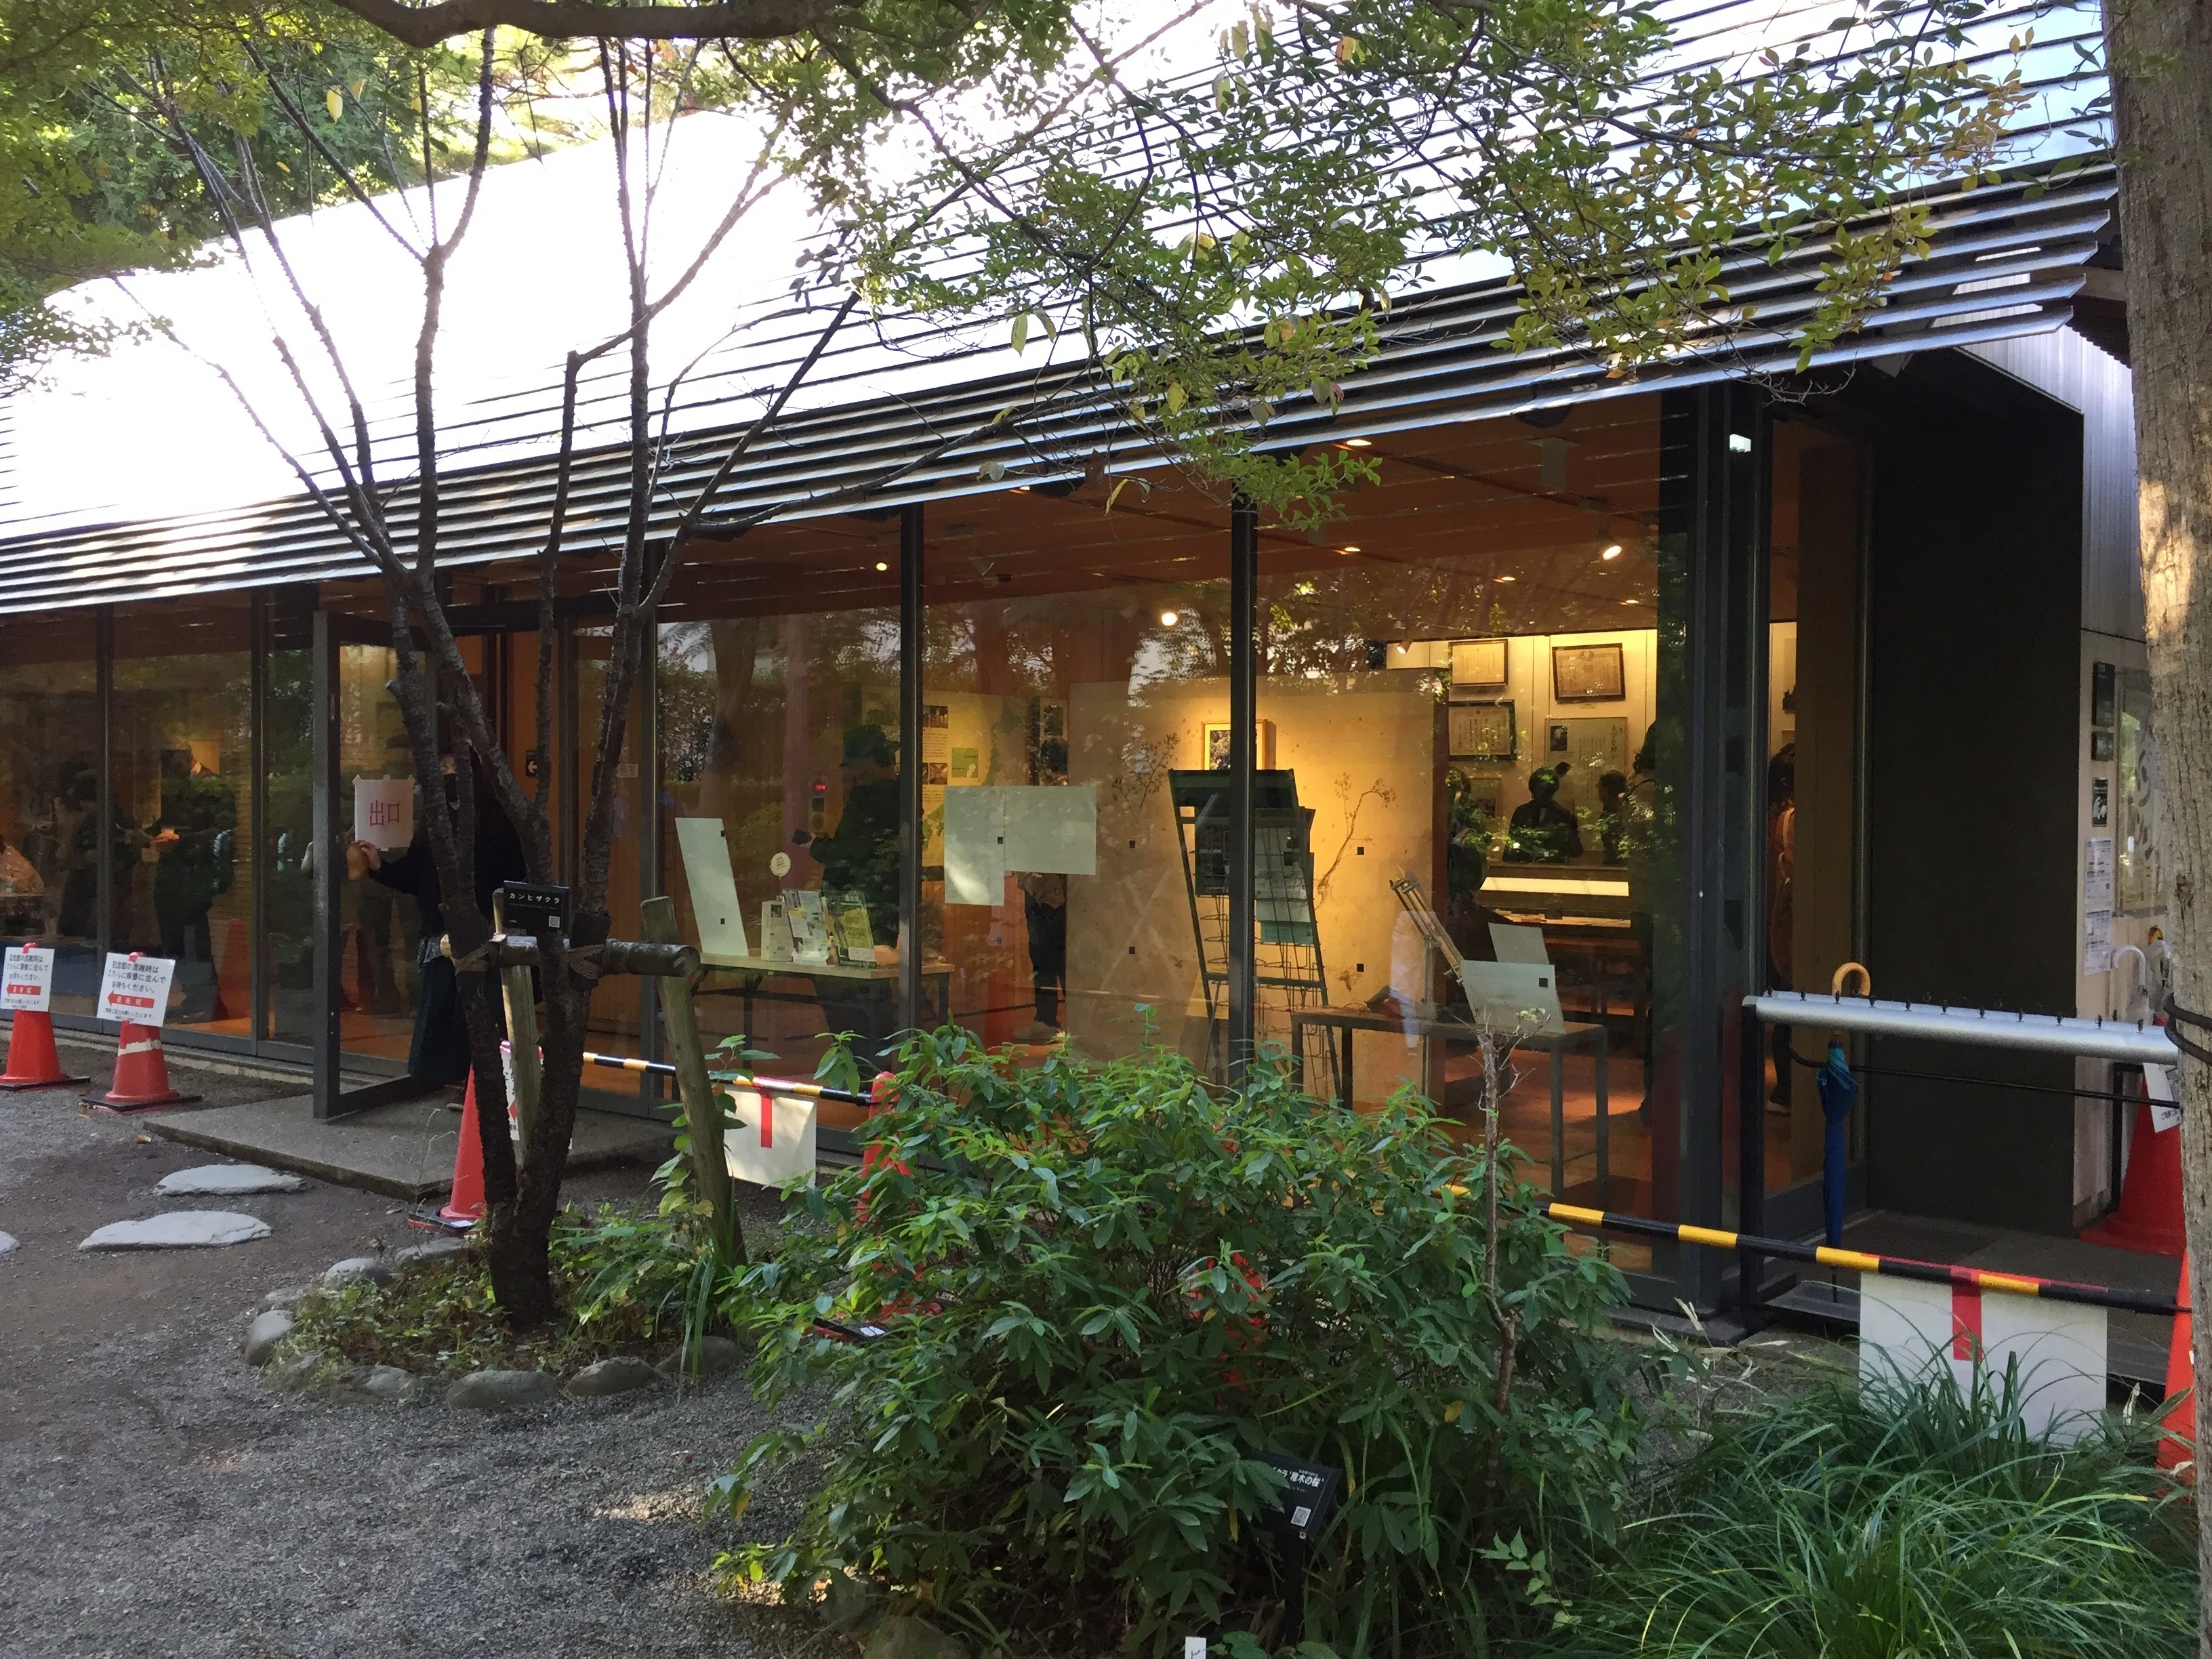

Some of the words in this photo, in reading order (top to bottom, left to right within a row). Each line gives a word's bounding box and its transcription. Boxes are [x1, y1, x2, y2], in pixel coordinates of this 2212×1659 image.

[370, 800, 400, 827] 出口
[509, 893, 560, 903] カンヒザクラ
